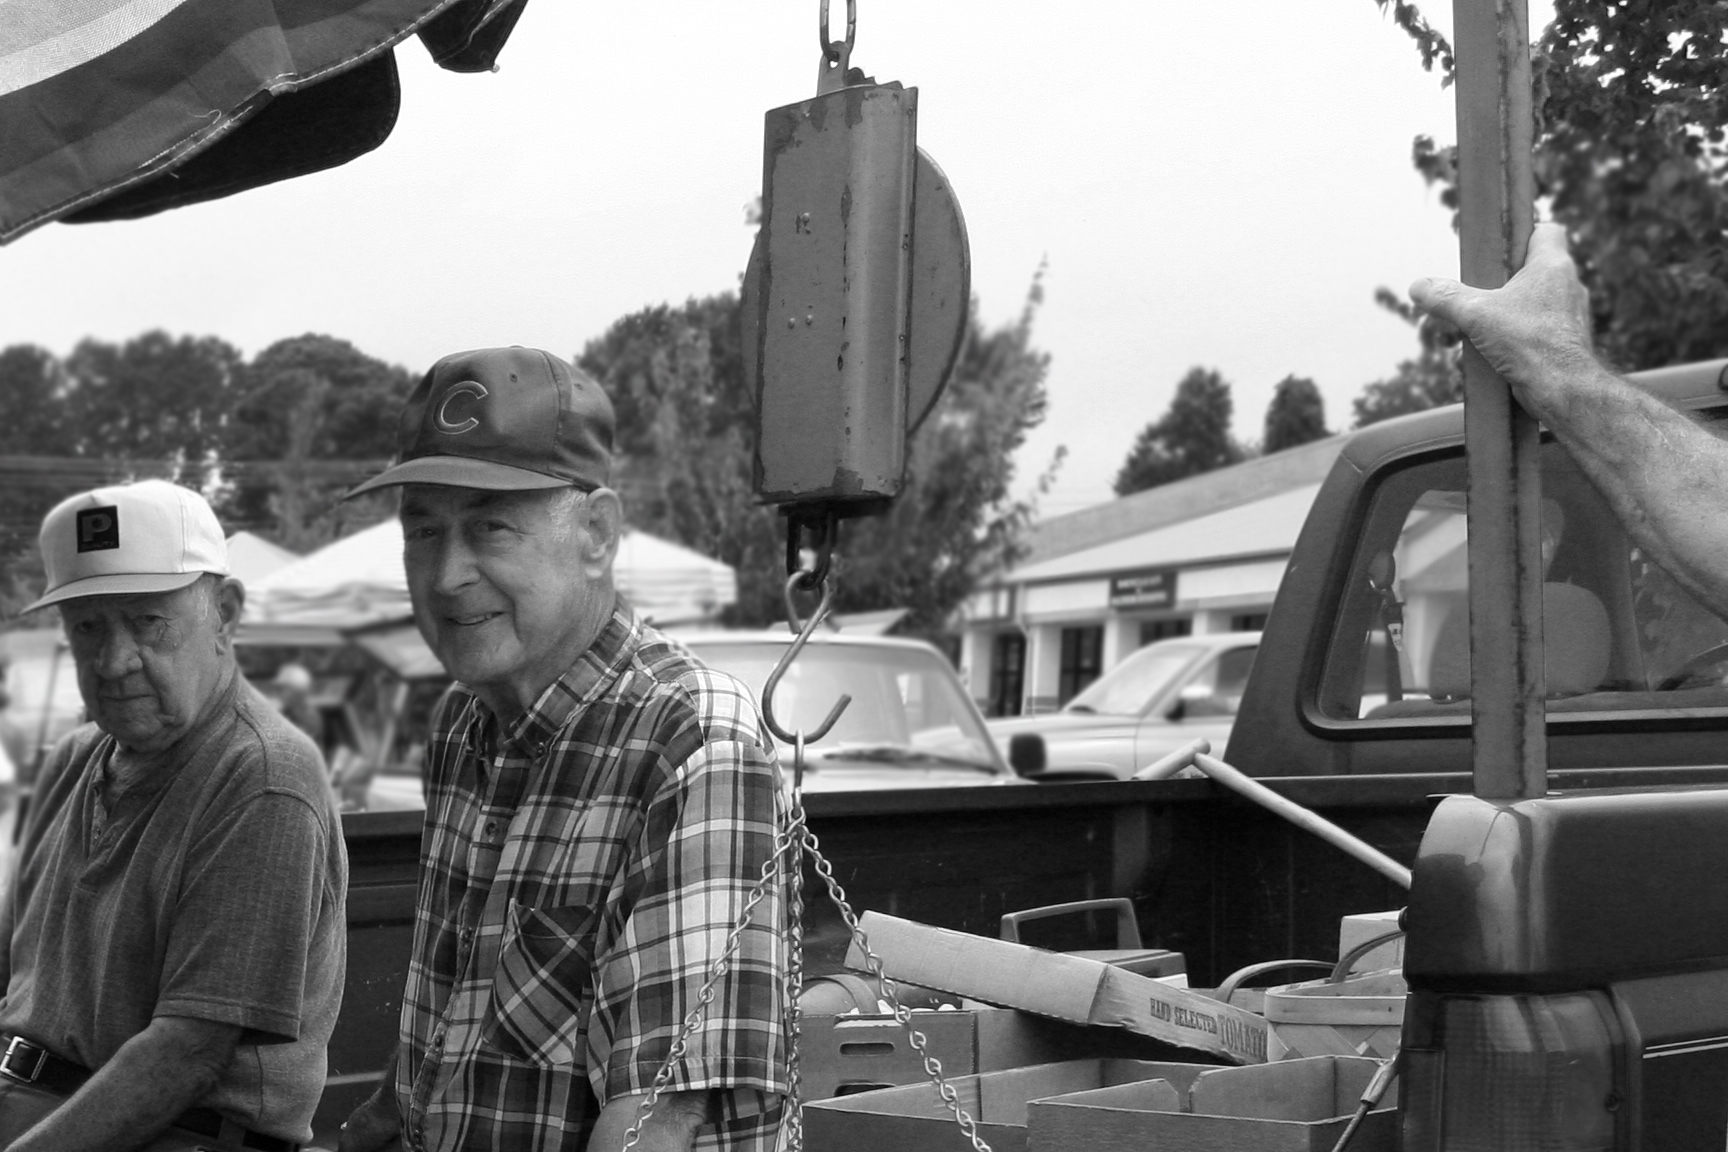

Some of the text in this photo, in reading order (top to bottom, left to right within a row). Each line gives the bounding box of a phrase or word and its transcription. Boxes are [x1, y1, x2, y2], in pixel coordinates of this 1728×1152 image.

[433, 380, 489, 434] C
[82, 513, 112, 542] P
[1150, 997, 1268, 1062] HAND SELECTED TOMATO
